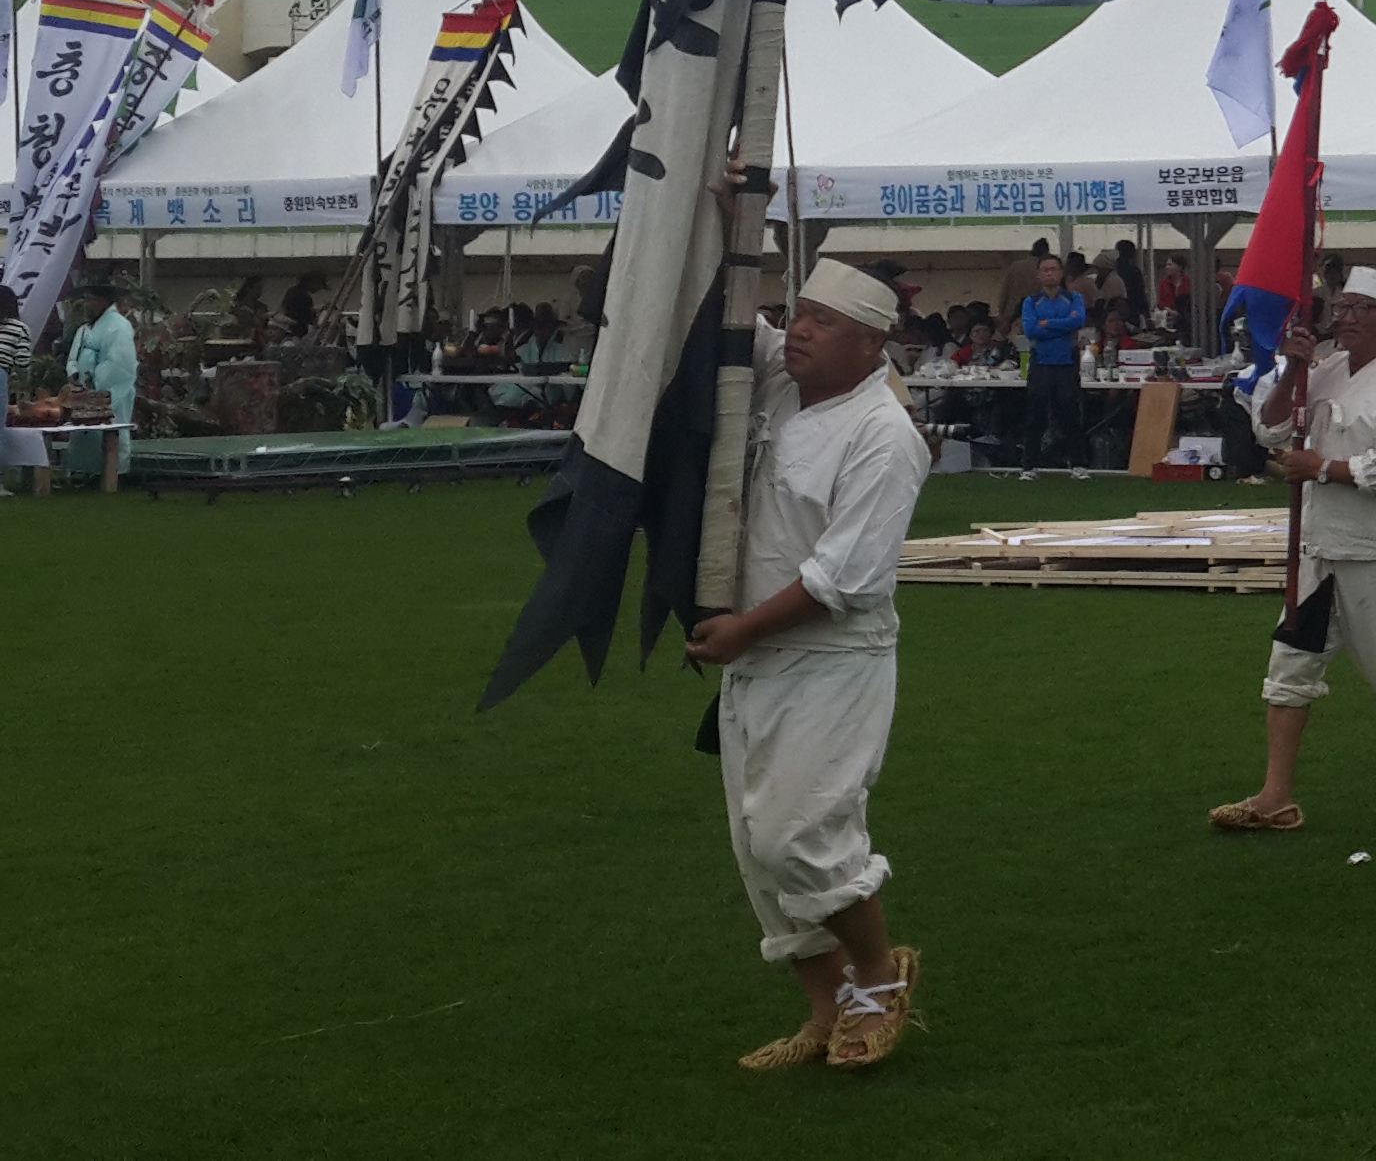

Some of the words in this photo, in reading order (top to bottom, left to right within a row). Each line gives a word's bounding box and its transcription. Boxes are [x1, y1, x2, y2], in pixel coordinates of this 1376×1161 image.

[458, 191, 500, 222] 봉양
[880, 182, 966, 215] 정이품송과
[975, 181, 1046, 214] 세조임금
[1054, 179, 1128, 213] 어가행렬
[1166, 187, 1240, 207] 풍물연합회
